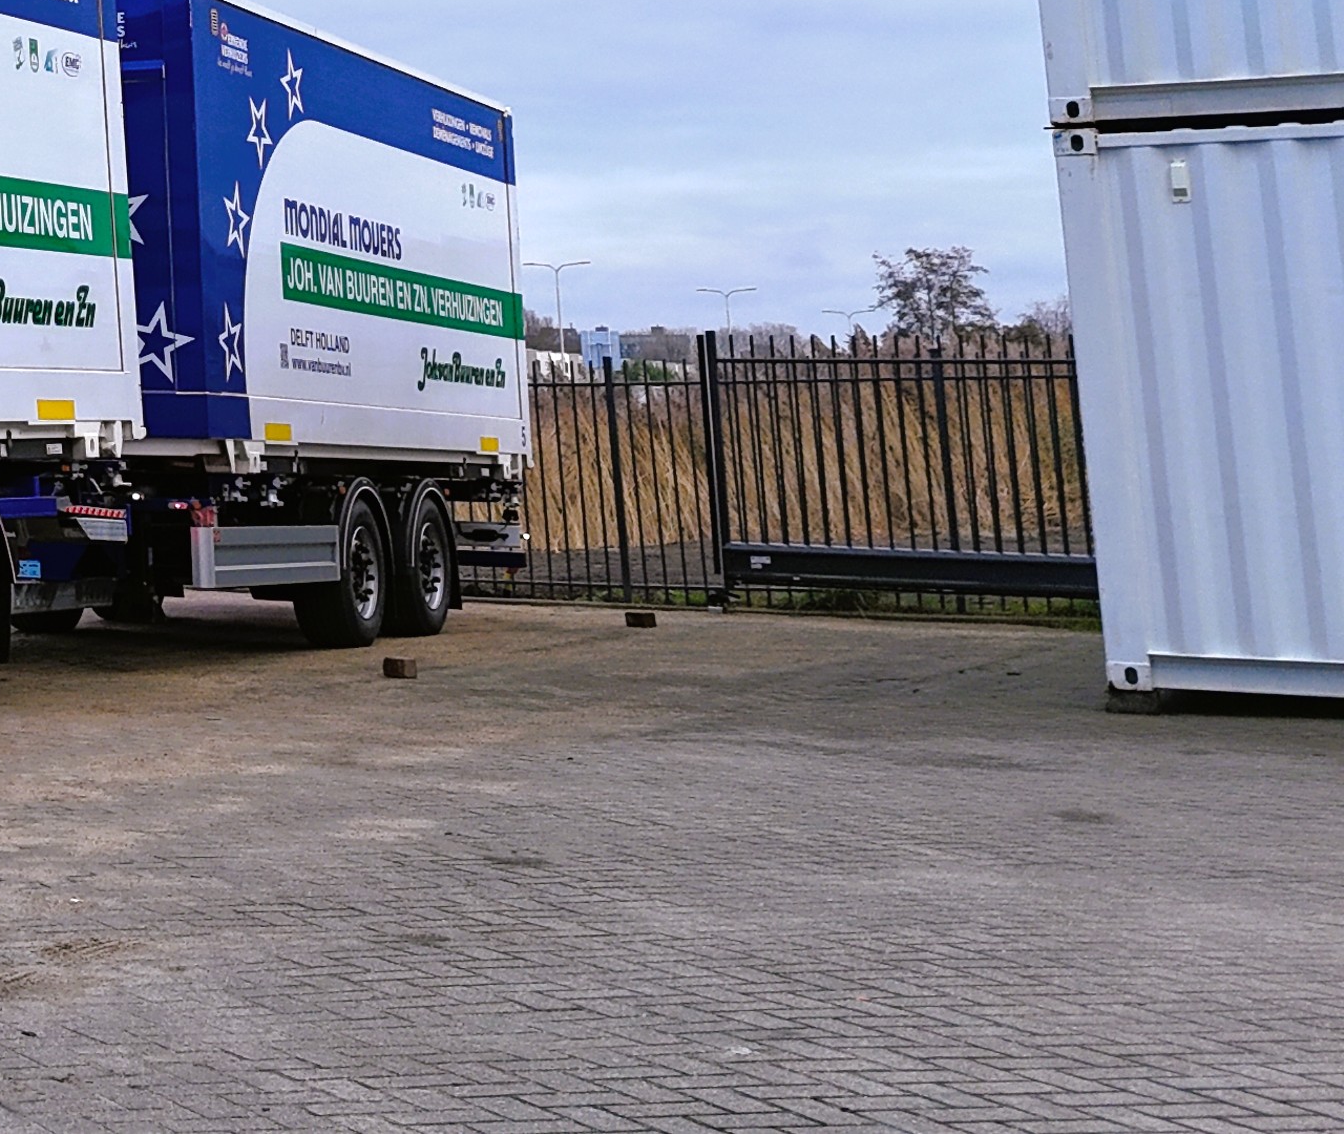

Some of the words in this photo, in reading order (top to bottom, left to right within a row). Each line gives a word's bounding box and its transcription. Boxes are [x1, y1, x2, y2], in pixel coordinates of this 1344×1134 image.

[284, 198, 347, 248] MONDIAL
[349, 215, 402, 261] MOVERS
[287, 257, 317, 293] JOH.
[317, 263, 344, 298] VAN
[345, 269, 395, 308] BUUREN
[396, 280, 412, 311] EN
[413, 284, 431, 314] ZN.
[431, 287, 504, 327] VERHUIZINGEN
[291, 328, 313, 348] DELFT
[315, 332, 350, 354] HOLLAND
[522, 426, 527, 447] 5
